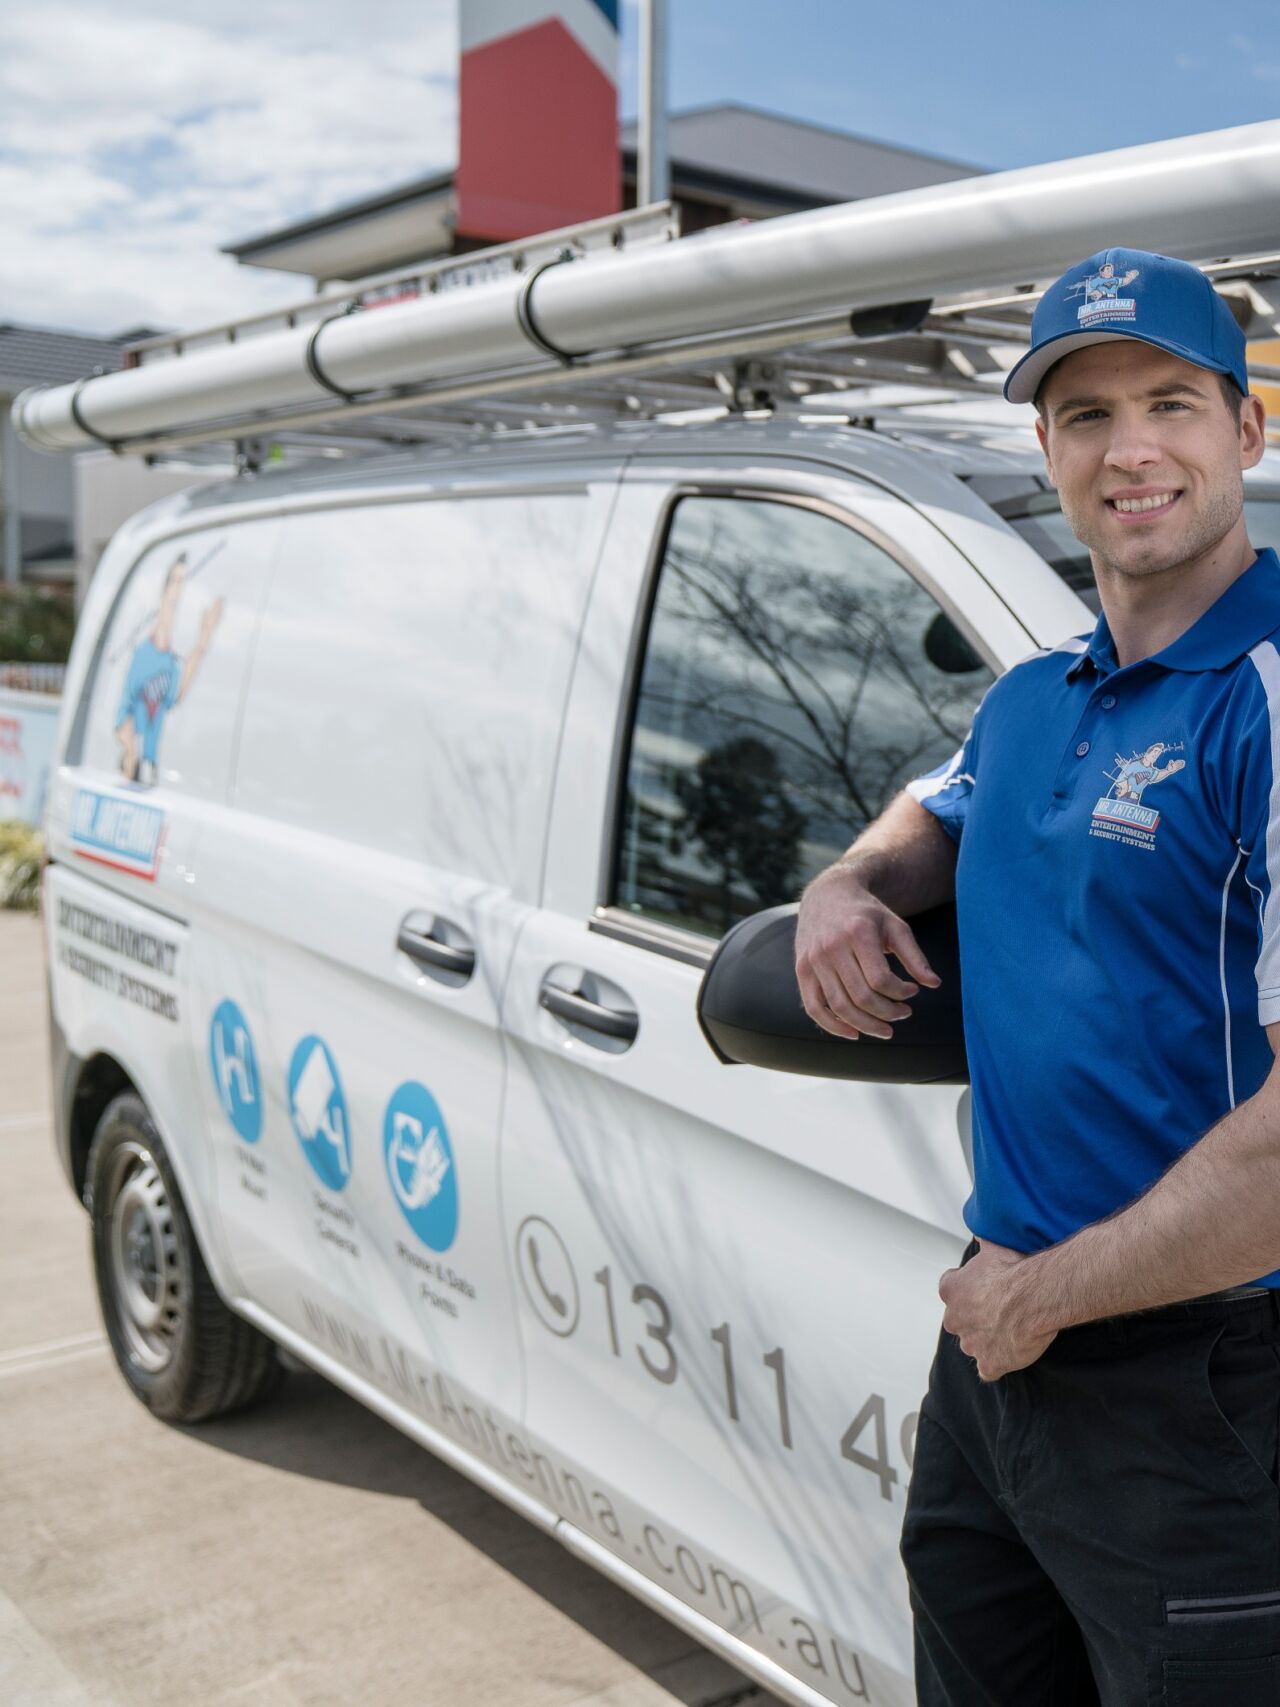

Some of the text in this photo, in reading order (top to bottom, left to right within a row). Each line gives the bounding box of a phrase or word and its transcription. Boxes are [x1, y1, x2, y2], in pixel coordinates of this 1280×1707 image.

[1095, 300, 1131, 311] ANTENNA
[1080, 312, 1136, 325] ENTERTAINMENT
[1111, 803, 1153, 824] ANTENNA
[1091, 820, 1156, 842] ENTERTAINMENT
[1093, 830, 1121, 842] SECURITY
[1121, 836, 1155, 851] SYSTEMS
[594, 1265, 679, 1385] 13
[711, 1322, 793, 1450] 11
